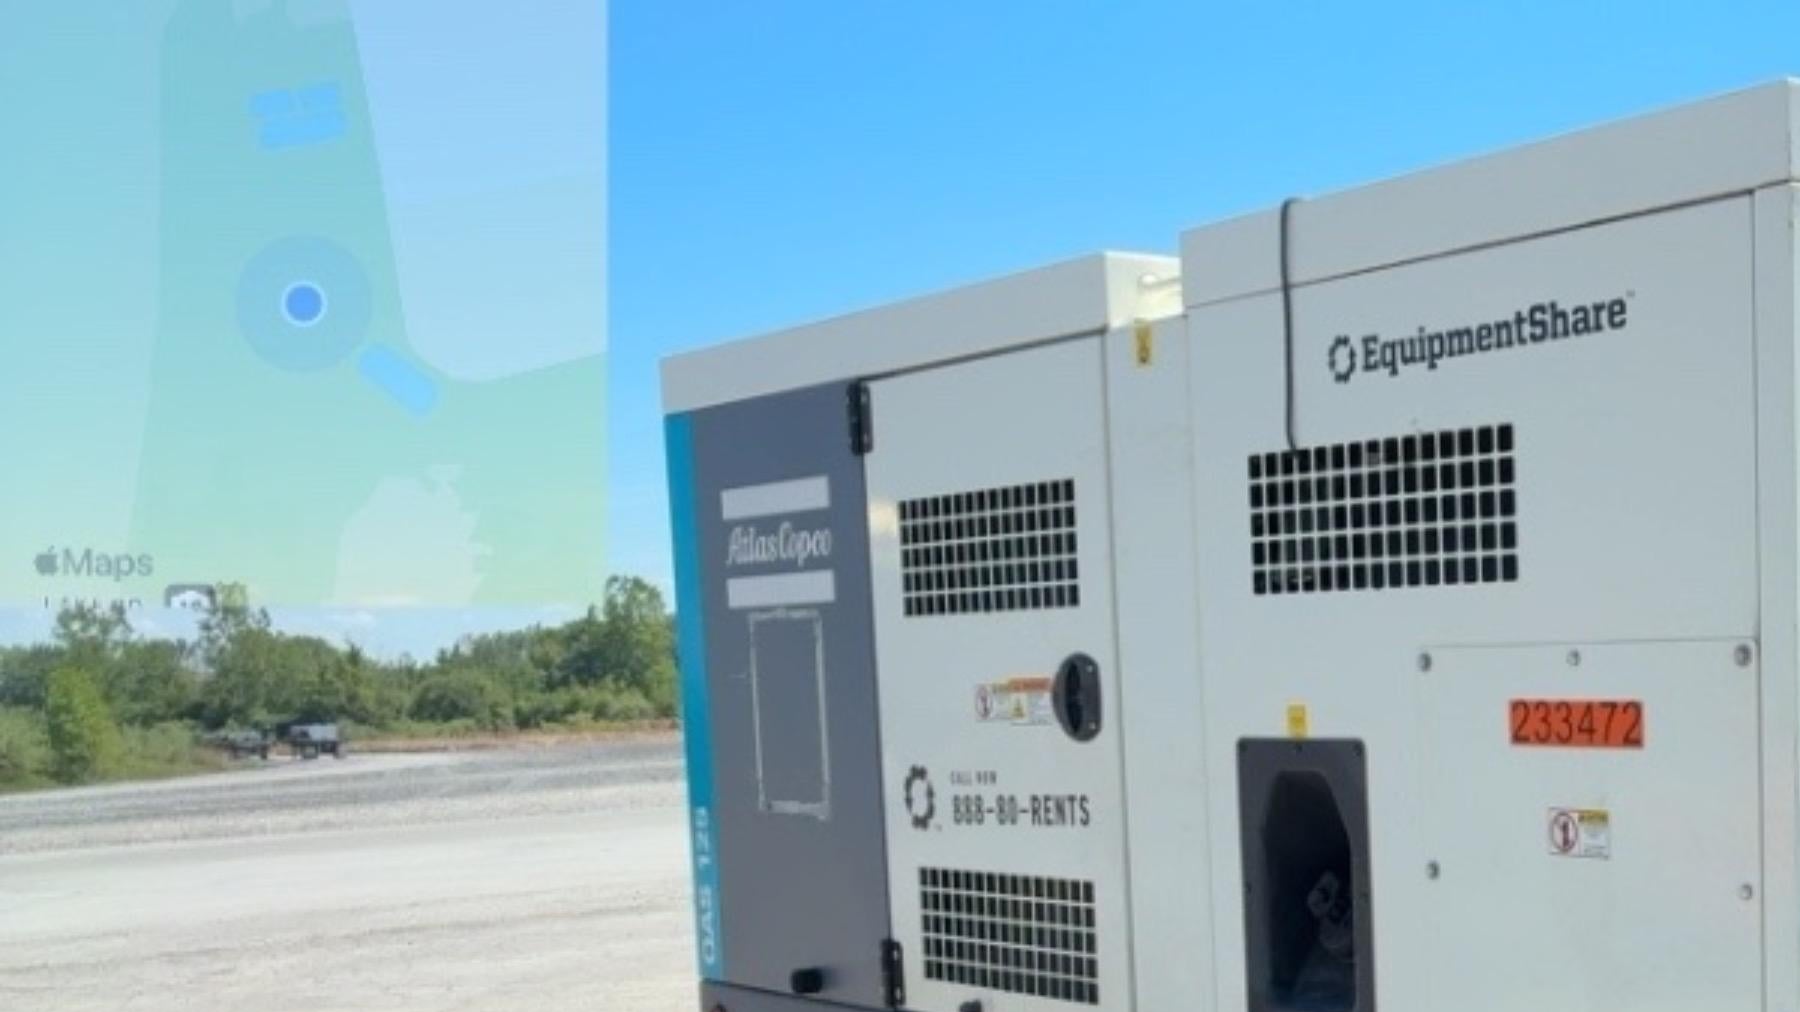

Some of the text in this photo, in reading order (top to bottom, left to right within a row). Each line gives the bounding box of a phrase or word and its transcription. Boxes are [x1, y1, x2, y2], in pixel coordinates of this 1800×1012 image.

[1361, 297, 1627, 376] EquipmentShare
[1511, 699, 1643, 747] 233472
[953, 794, 1090, 826] 888-80-RENTS
